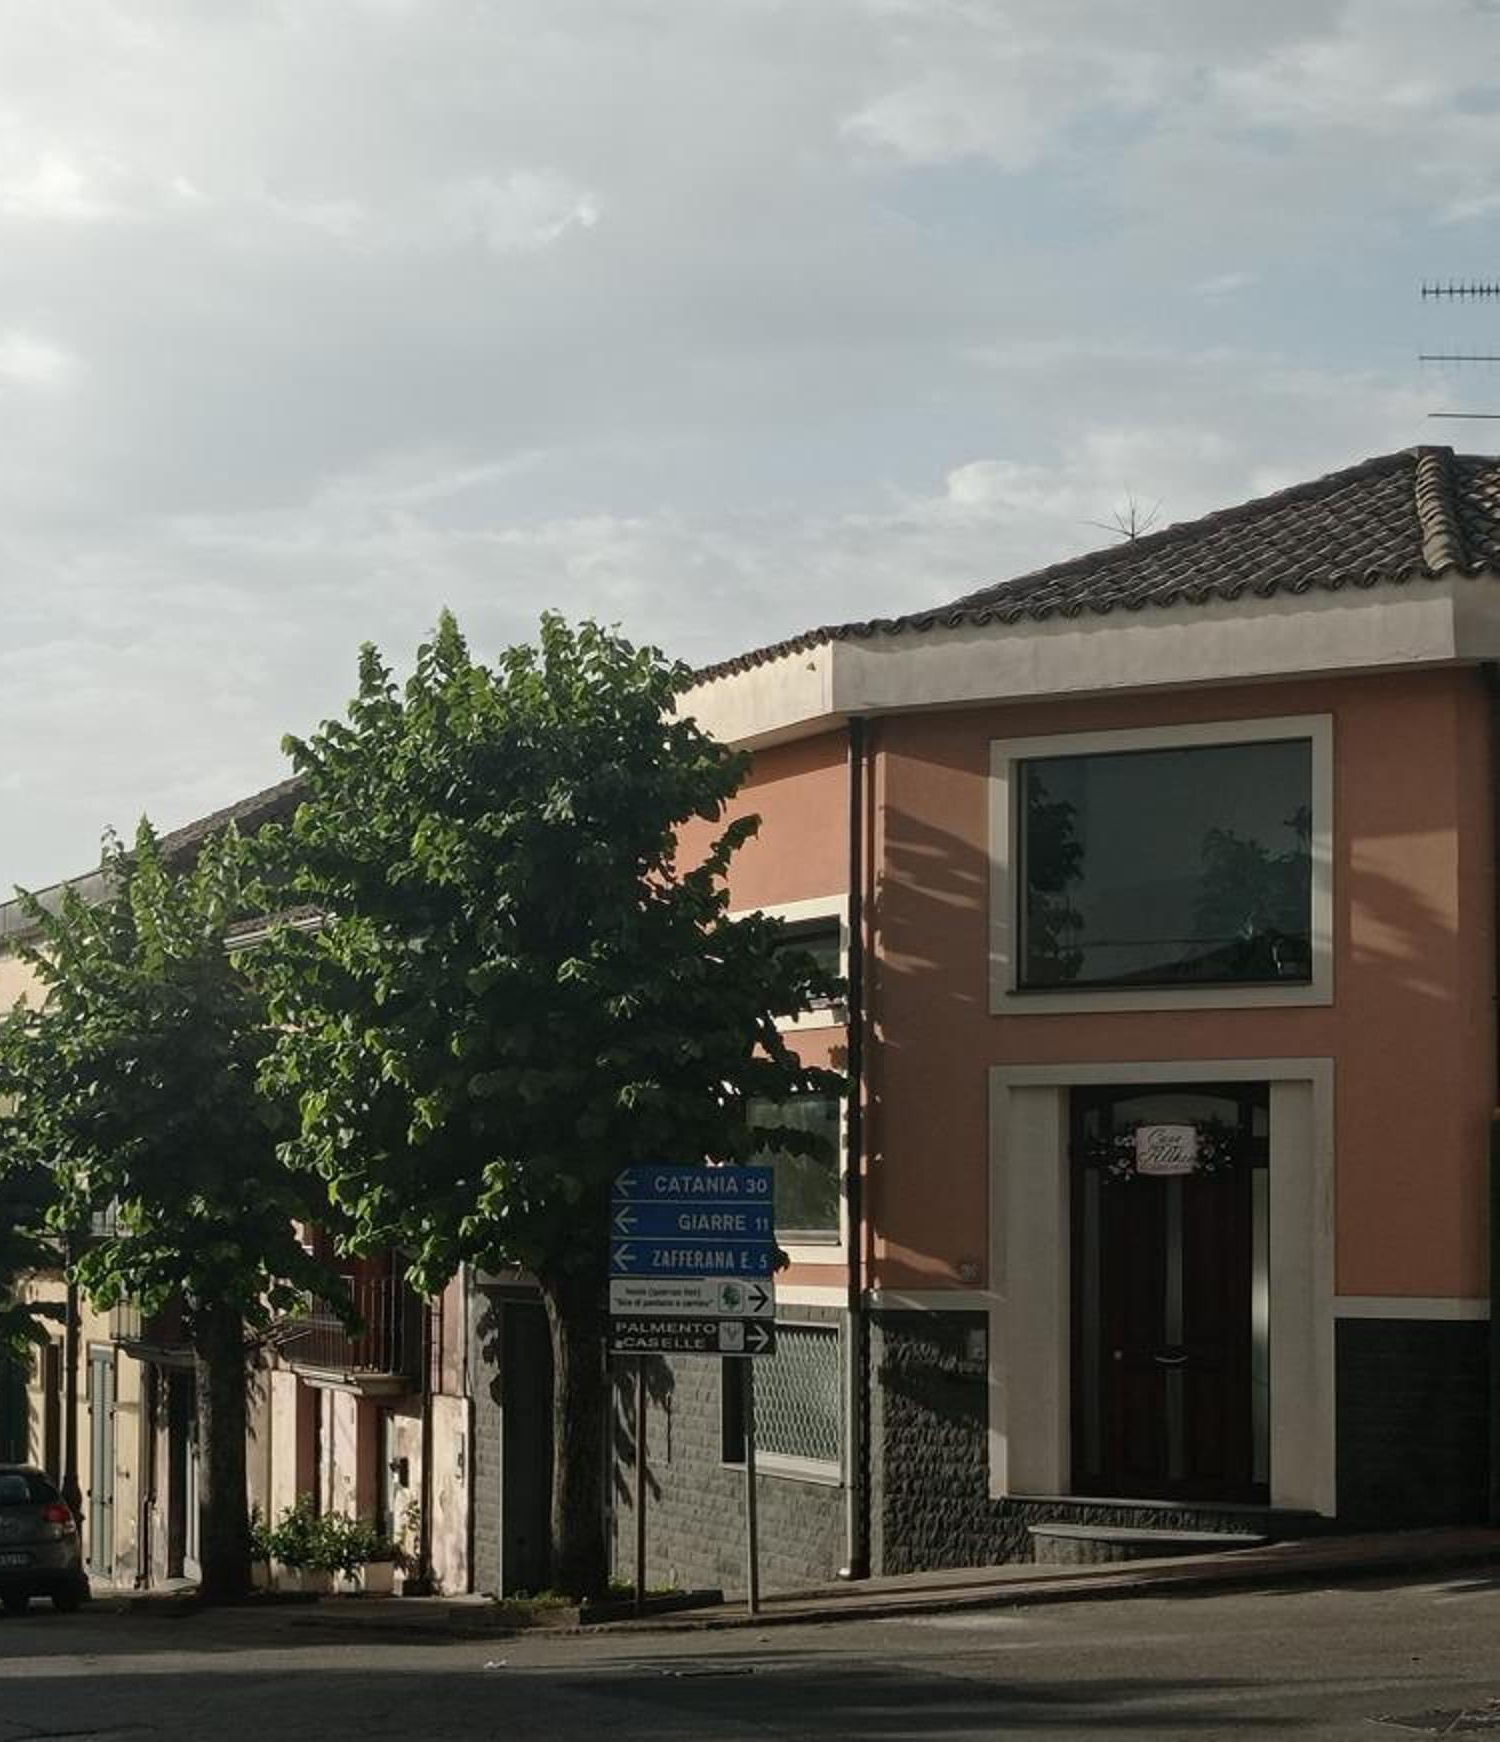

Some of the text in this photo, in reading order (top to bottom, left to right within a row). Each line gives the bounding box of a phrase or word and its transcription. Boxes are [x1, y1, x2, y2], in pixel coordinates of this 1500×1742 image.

[654, 1175, 768, 1193] CATANIA 30
[678, 1213, 770, 1232] GIARRE 11
[651, 1250, 735, 1268] ZAFFERANA
[760, 1253, 768, 1269] 5
[615, 1322, 717, 1334] PALMENTO
